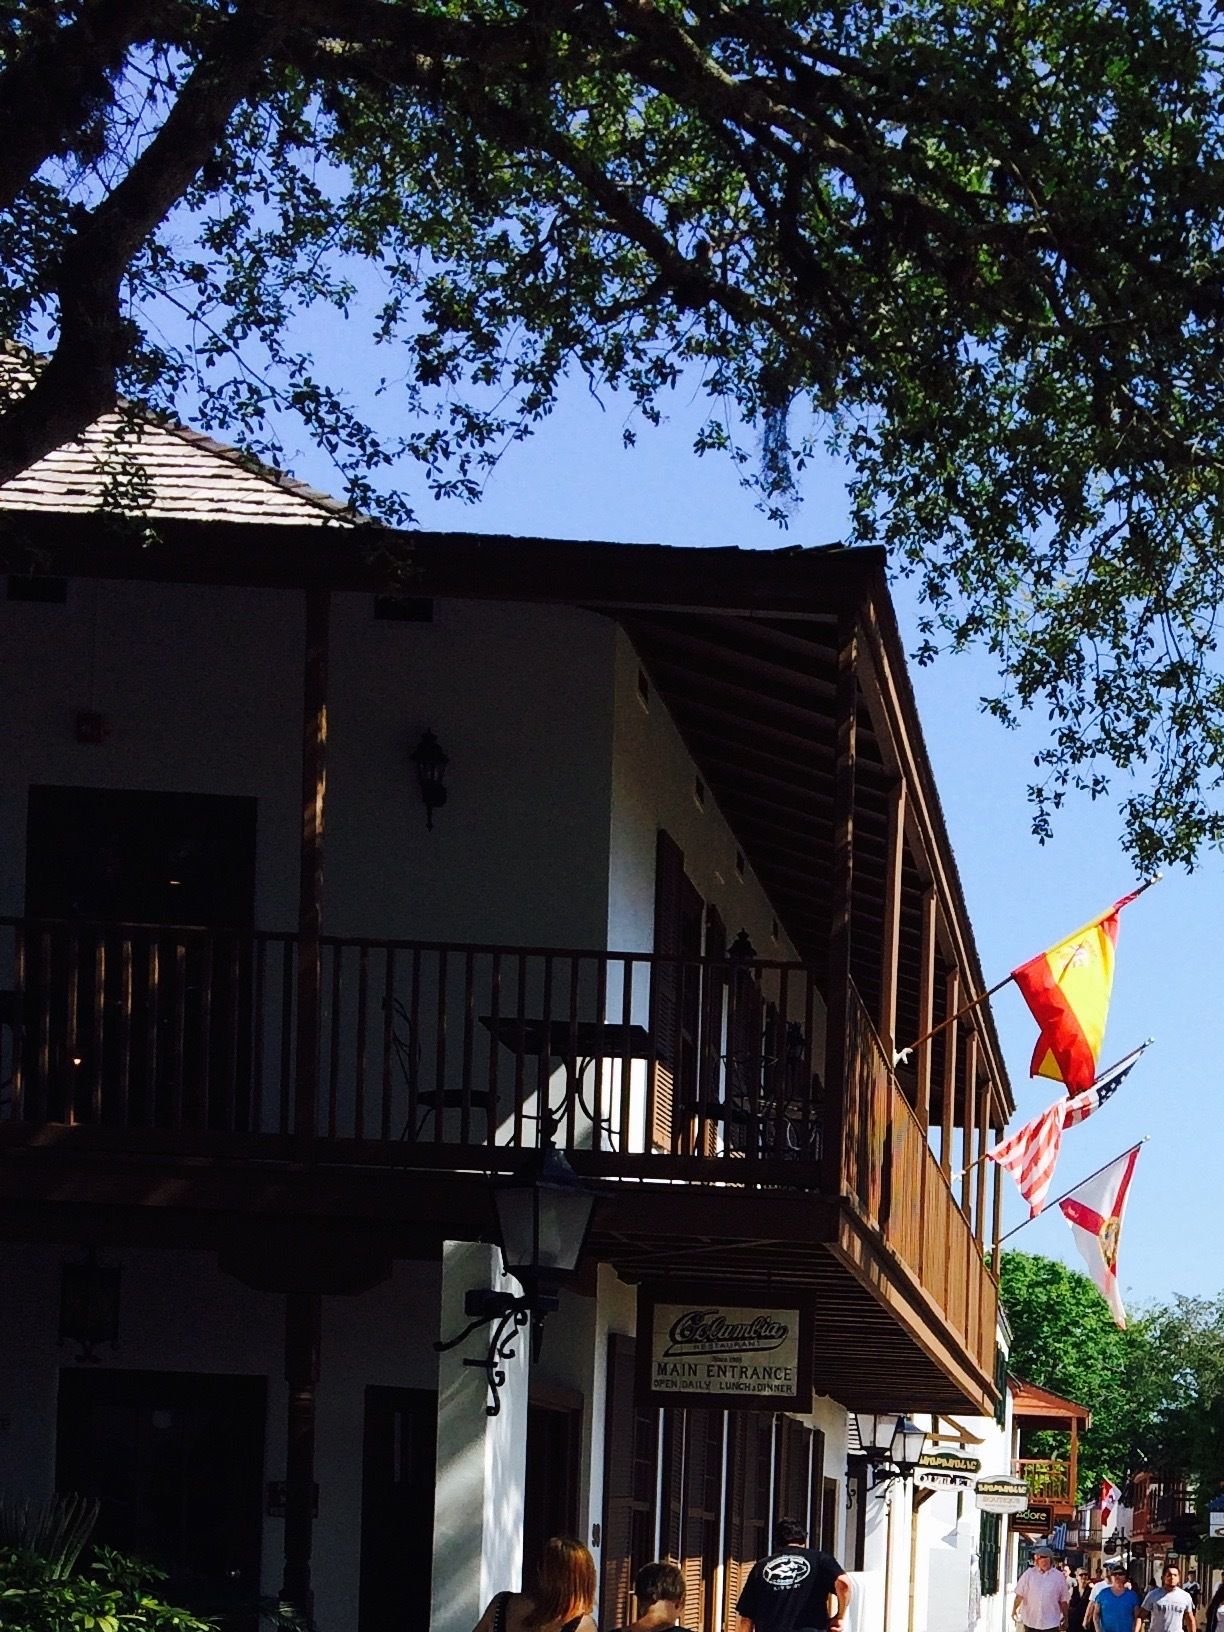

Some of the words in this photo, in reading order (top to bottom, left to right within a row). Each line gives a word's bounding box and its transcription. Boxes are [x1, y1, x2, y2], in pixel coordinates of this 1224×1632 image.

[669, 1310, 788, 1344] Columbia
[693, 1340, 761, 1350] RESTAURANT
[657, 1362, 698, 1377] MAIN
[706, 1364, 792, 1381] ENTRANCE
[653, 1379, 678, 1388] OPEN
[681, 1379, 711, 1390] DAILY
[719, 1381, 750, 1391] LUNCH
[757, 1383, 793, 1393] DINNER
